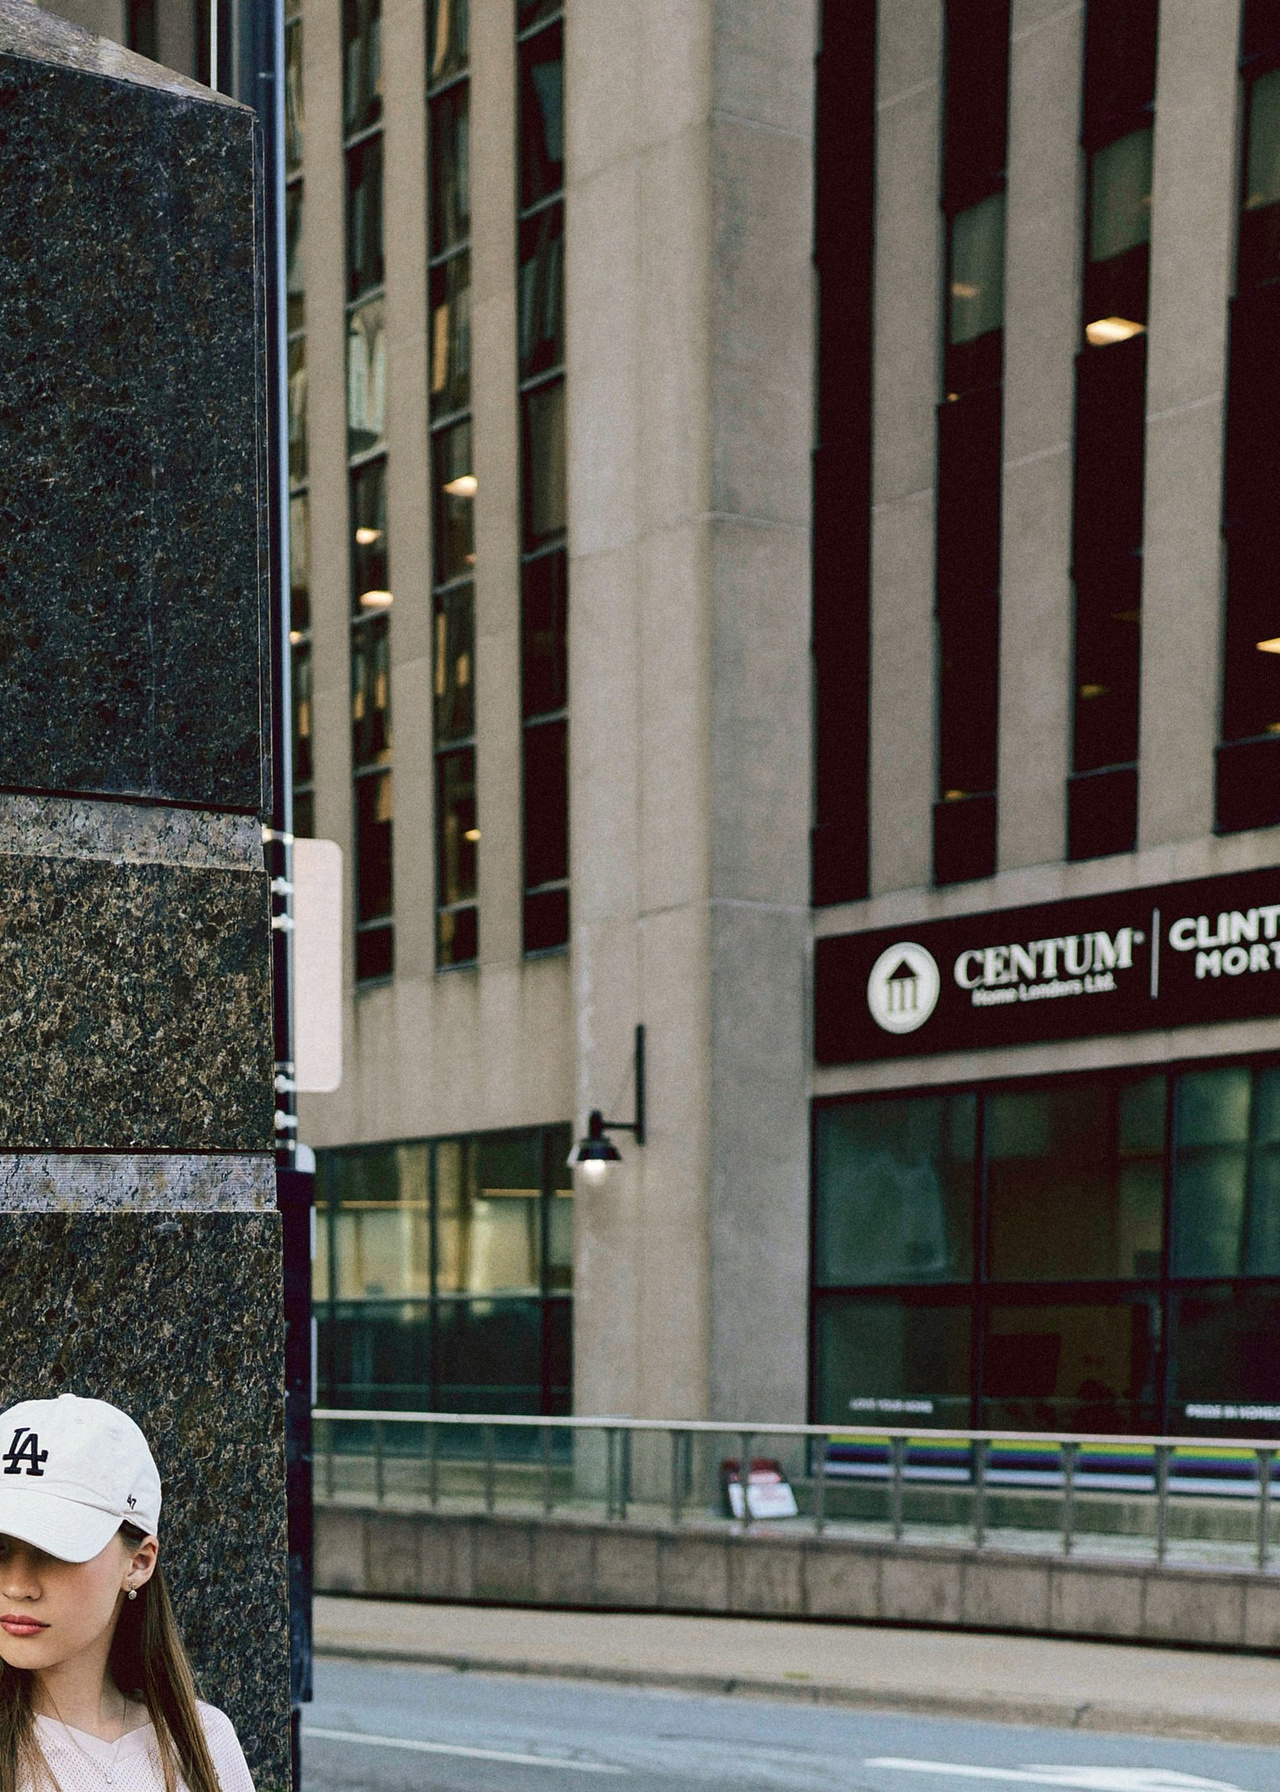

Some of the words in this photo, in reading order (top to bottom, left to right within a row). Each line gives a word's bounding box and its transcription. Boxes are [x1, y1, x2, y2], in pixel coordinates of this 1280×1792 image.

[1169, 904, 1280, 951] CLINT
[954, 927, 1134, 989] CENTUM
[972, 987, 1018, 1007] Home
[2, 1427, 49, 1476] LA
